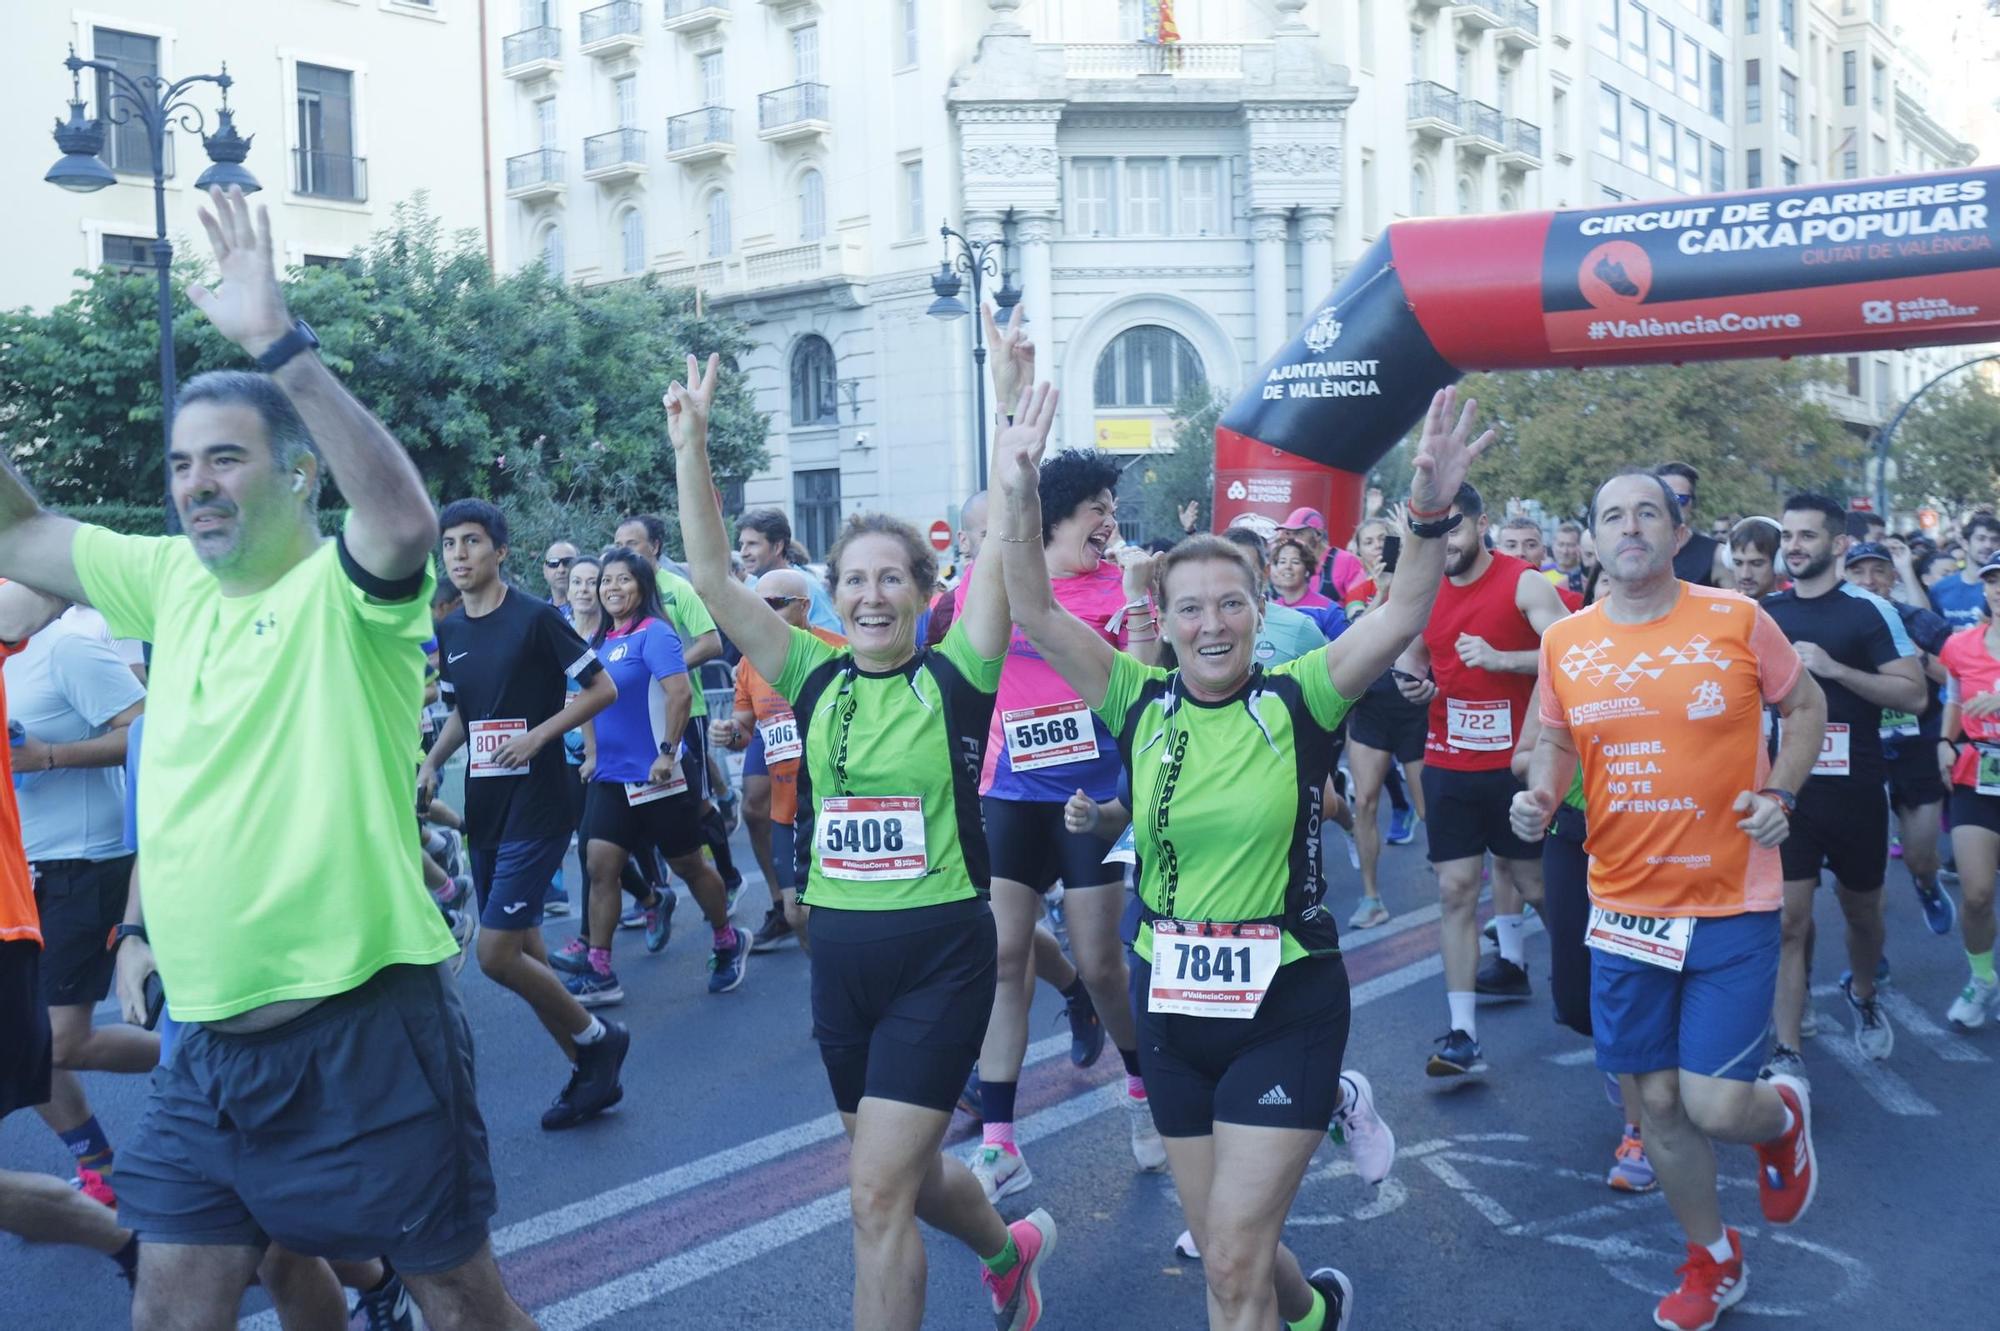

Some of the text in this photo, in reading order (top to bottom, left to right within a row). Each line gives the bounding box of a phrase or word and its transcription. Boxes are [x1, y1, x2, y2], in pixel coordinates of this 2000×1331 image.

[1580, 180, 1986, 236] CIRCUIT DE CARRERES
[1802, 233, 1992, 266] CIUTAT DE VALÈNCIA
[1897, 297, 1949, 311] caixa
[1899, 303, 1979, 322] popular
[1587, 312, 1802, 340] #ValènciaCorre
[1267, 360, 1380, 382] AJUNTAMENT
[1262, 379, 1381, 400] DE VALÈNCIA
[1583, 697, 1641, 713] CIRCUITO
[1458, 713, 1495, 729] 722
[768, 724, 799, 746] 506
[1016, 717, 1079, 748] 5568
[1603, 740, 1666, 757] QUIERE.
[1606, 760, 1662, 775] VUELA.
[1608, 780, 1652, 794] NO TE
[826, 818, 904, 853] 5408
[1174, 943, 1251, 983] 7841
[1258, 1097, 1292, 1105] adidas
